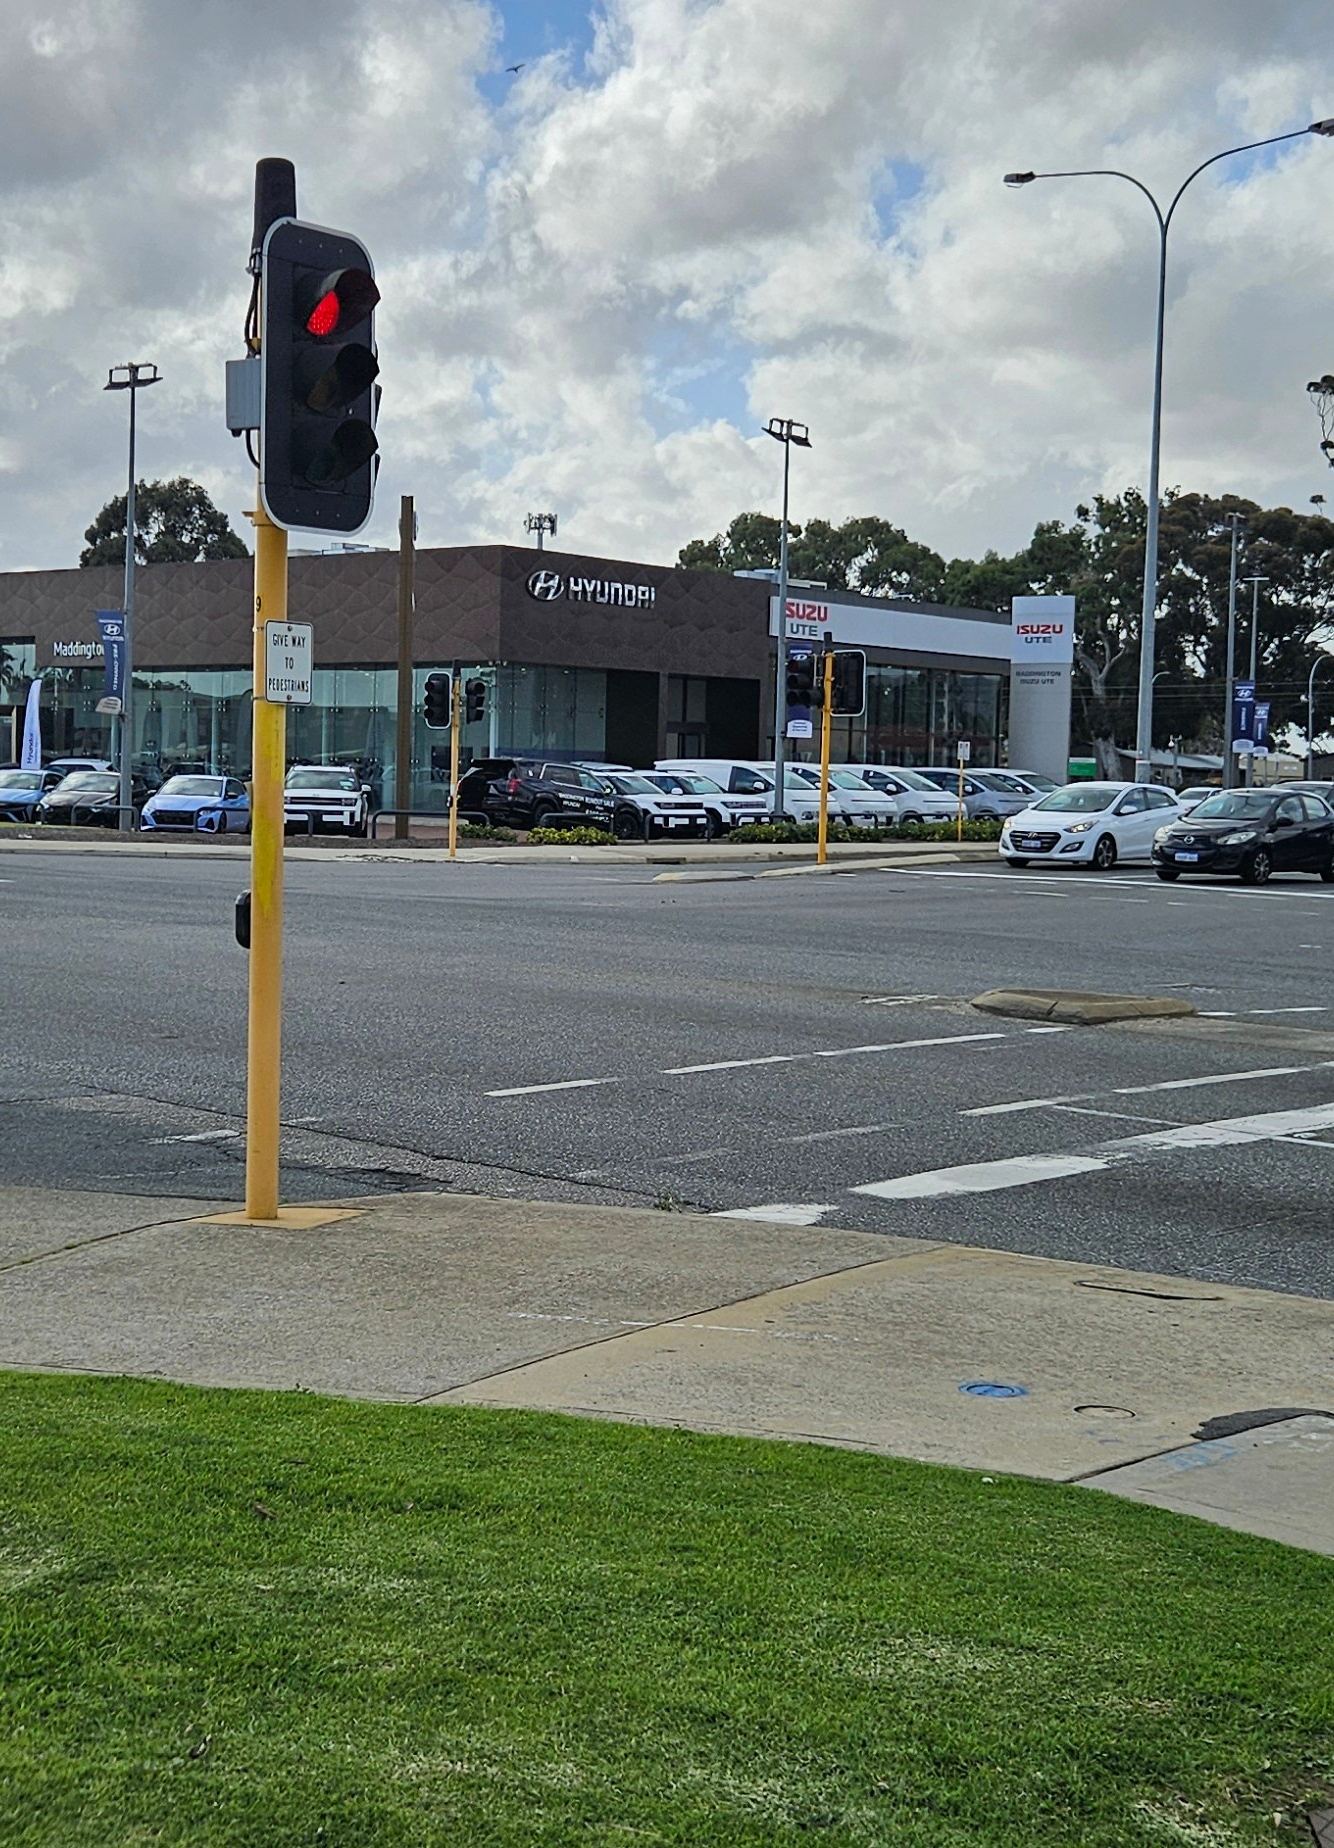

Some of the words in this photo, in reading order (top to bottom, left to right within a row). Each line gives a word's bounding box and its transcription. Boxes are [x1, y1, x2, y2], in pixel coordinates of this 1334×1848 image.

[569, 576, 655, 609] HYUNDAI
[785, 602, 827, 622] SUZU
[790, 622, 818, 637] UTE
[1016, 624, 1064, 635] ISUZU
[273, 634, 288, 648] GIVE
[291, 636, 306, 648] WAY
[1025, 636, 1052, 644] UTE
[285, 657, 294, 670] TO
[269, 677, 309, 693] PEDESTRIANS
